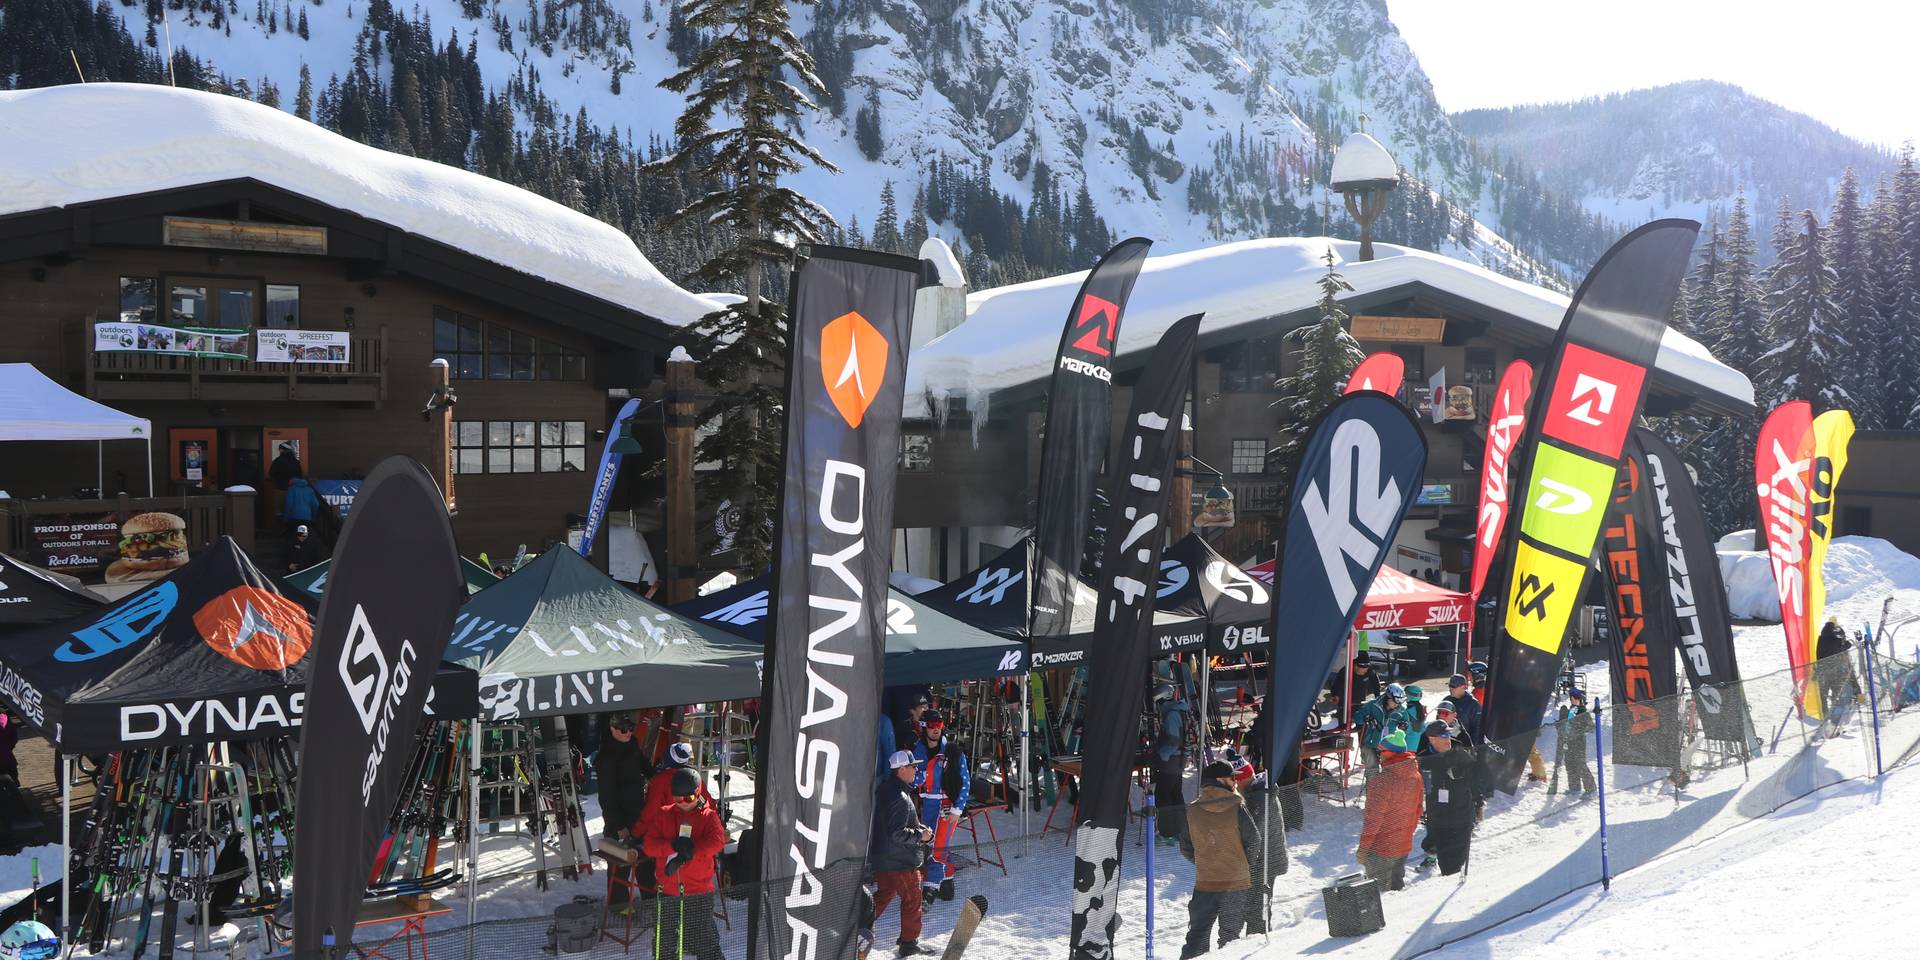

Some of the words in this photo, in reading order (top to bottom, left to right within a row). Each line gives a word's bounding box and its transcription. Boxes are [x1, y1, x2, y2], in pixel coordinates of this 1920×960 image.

[100, 326, 133, 334] outdoors
[298, 332, 334, 341] SPREEFEST
[321, 494, 356, 507] TURT
[33, 524, 70, 534] PROUD
[71, 522, 118, 532] SPONSOR
[1301, 418, 1402, 618] K2
[42, 540, 81, 549] OUTDOORS
[48, 554, 70, 566] Red
[70, 554, 98, 566] Robin
[1646, 453, 1712, 677] BLIZZARD
[1604, 513, 1661, 735] TECNICA
[528, 613, 689, 658] LINE
[997, 650, 1022, 671] K2
[1044, 650, 1084, 664] MARKER
[527, 668, 625, 712] LINE
[121, 691, 306, 742] DYNAS
[362, 638, 417, 808] salomon
